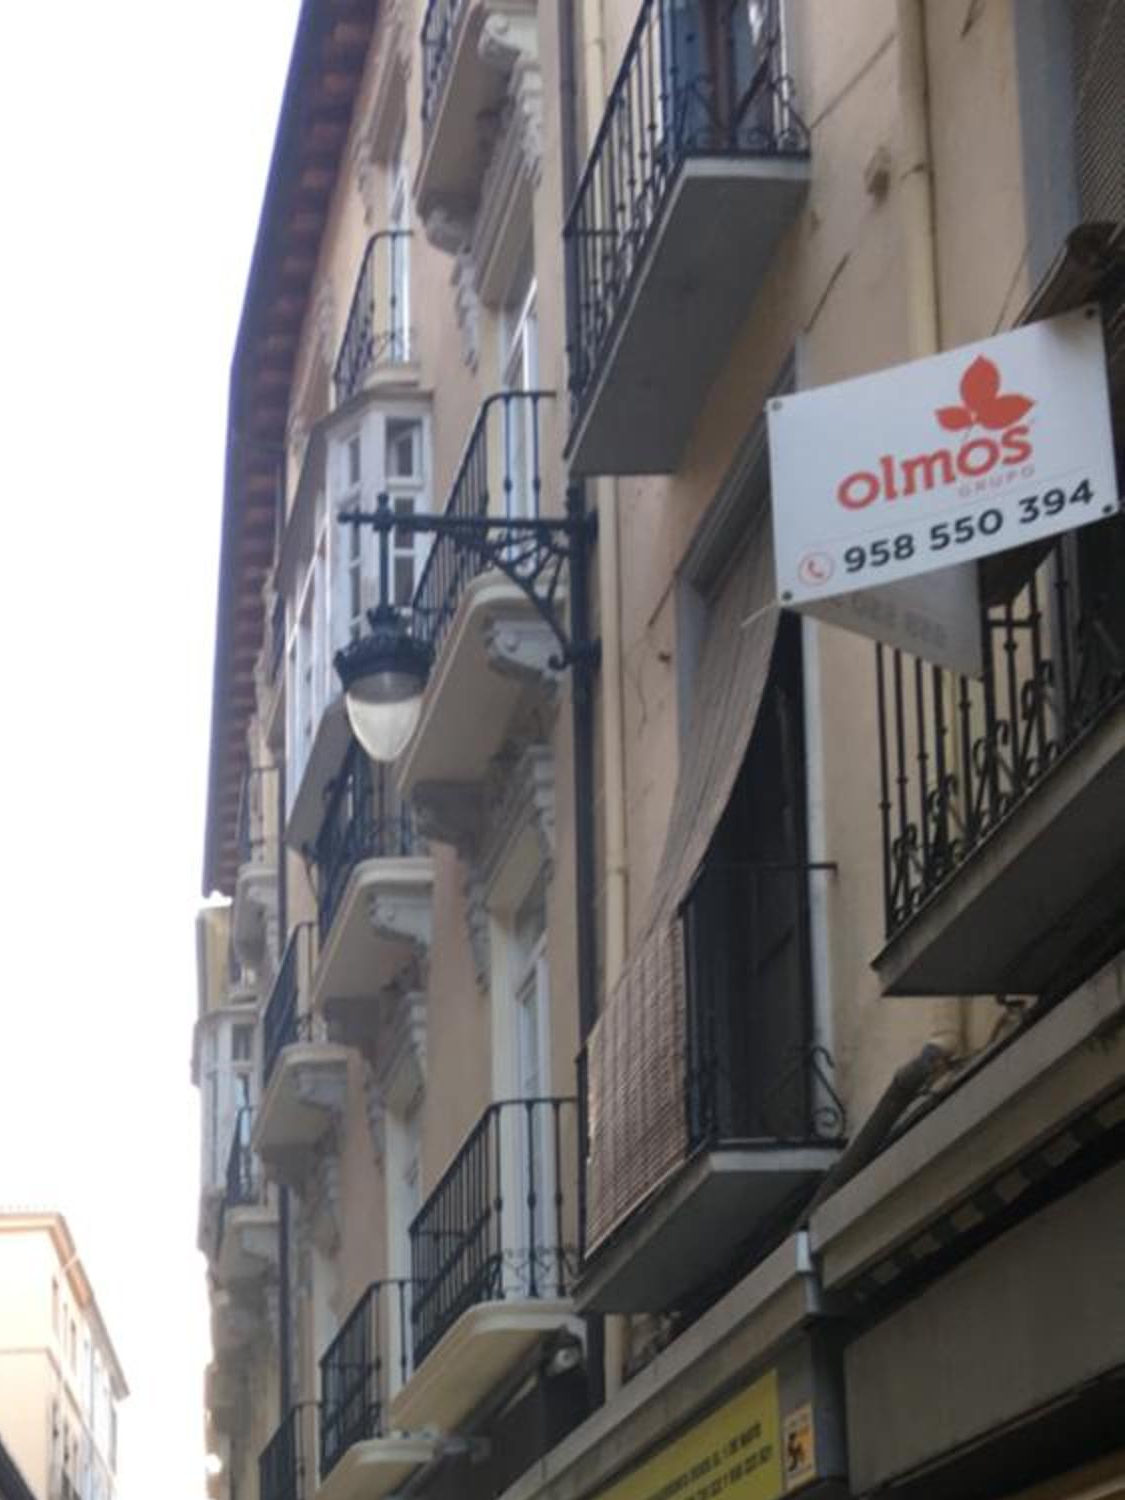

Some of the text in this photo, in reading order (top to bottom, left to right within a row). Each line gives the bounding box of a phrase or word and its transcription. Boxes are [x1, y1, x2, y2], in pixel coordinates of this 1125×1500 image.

[836, 424, 1034, 511] olmos
[958, 466, 1036, 498] GRUPO
[843, 478, 1095, 574] 958 550 394
